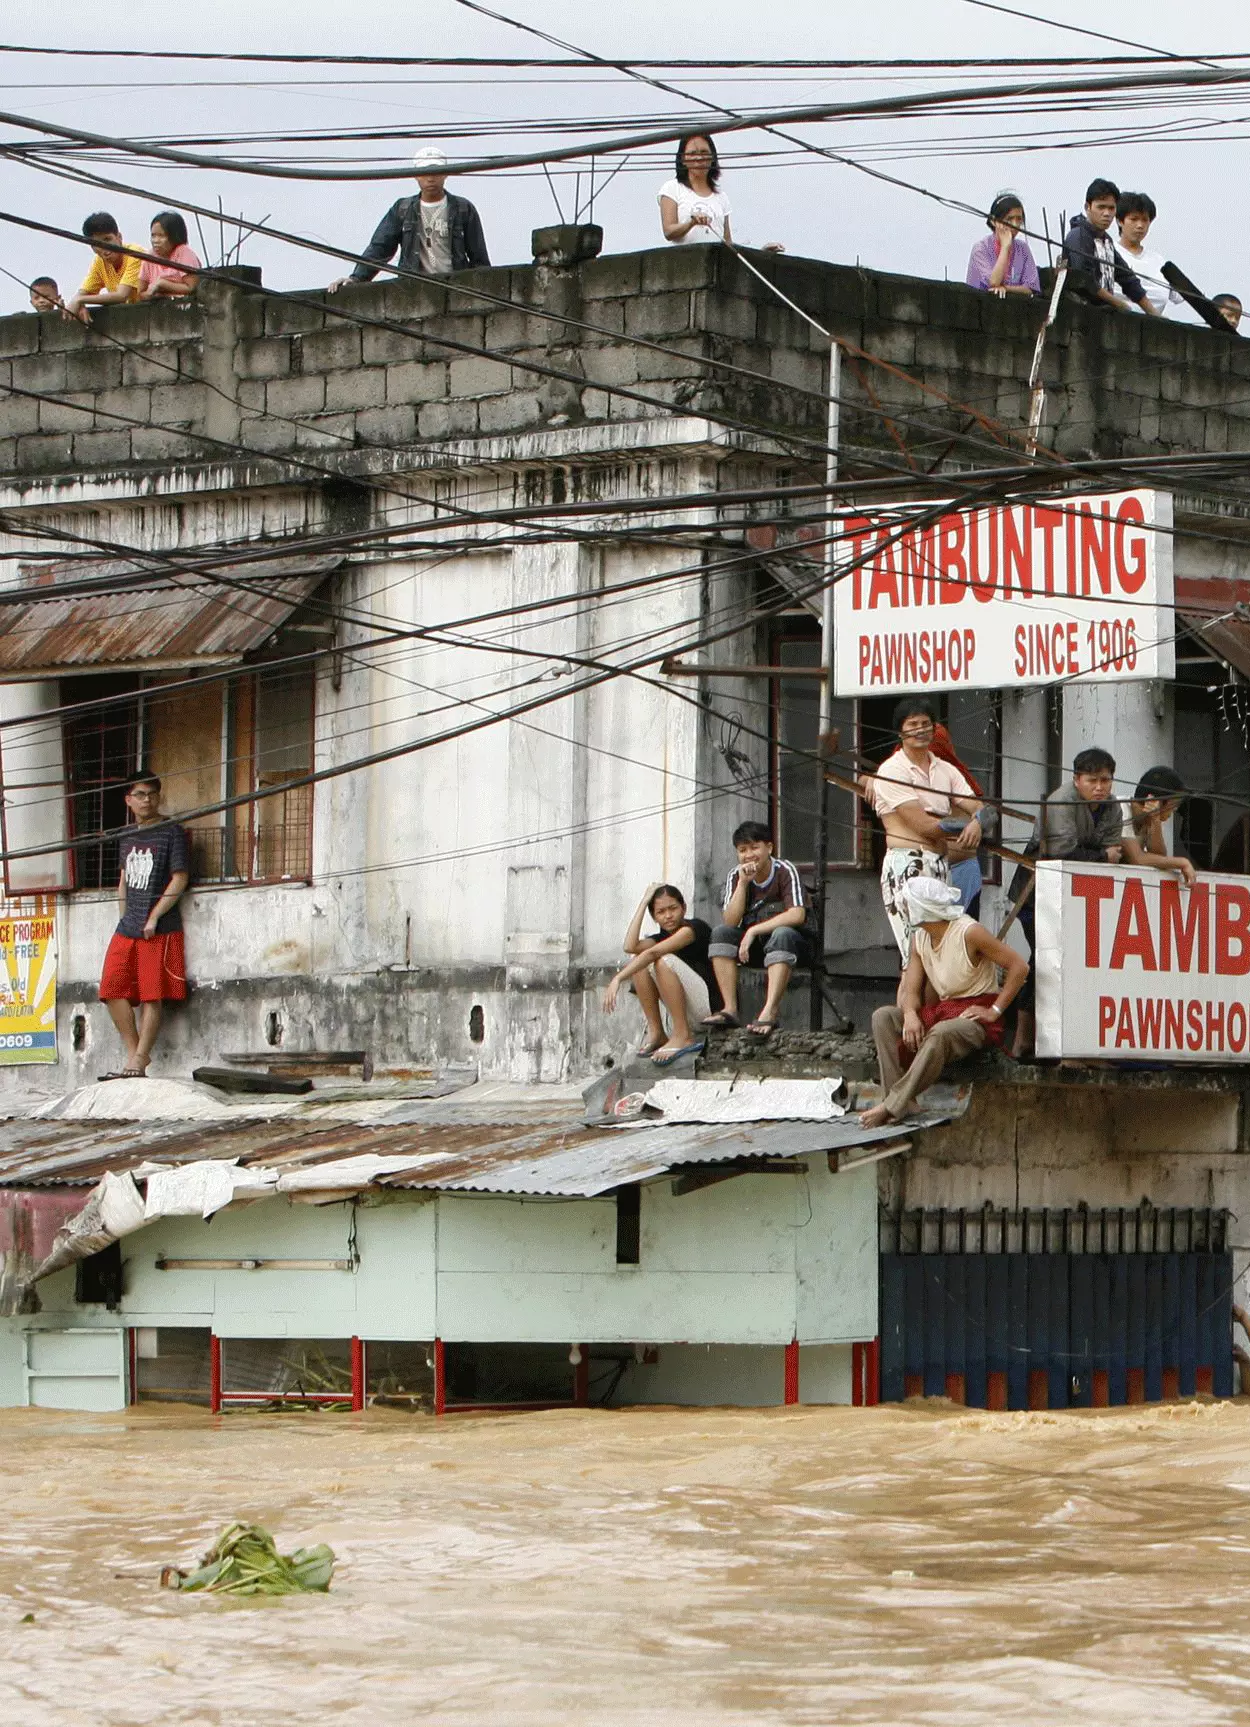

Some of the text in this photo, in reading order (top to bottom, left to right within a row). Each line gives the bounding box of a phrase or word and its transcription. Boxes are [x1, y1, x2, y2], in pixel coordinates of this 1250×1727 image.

[844, 496, 1146, 610] TAMBUNTING
[859, 617, 1137, 686] PAWNSHOP SINCE 1906
[14, 920, 54, 941] PROGRAM
